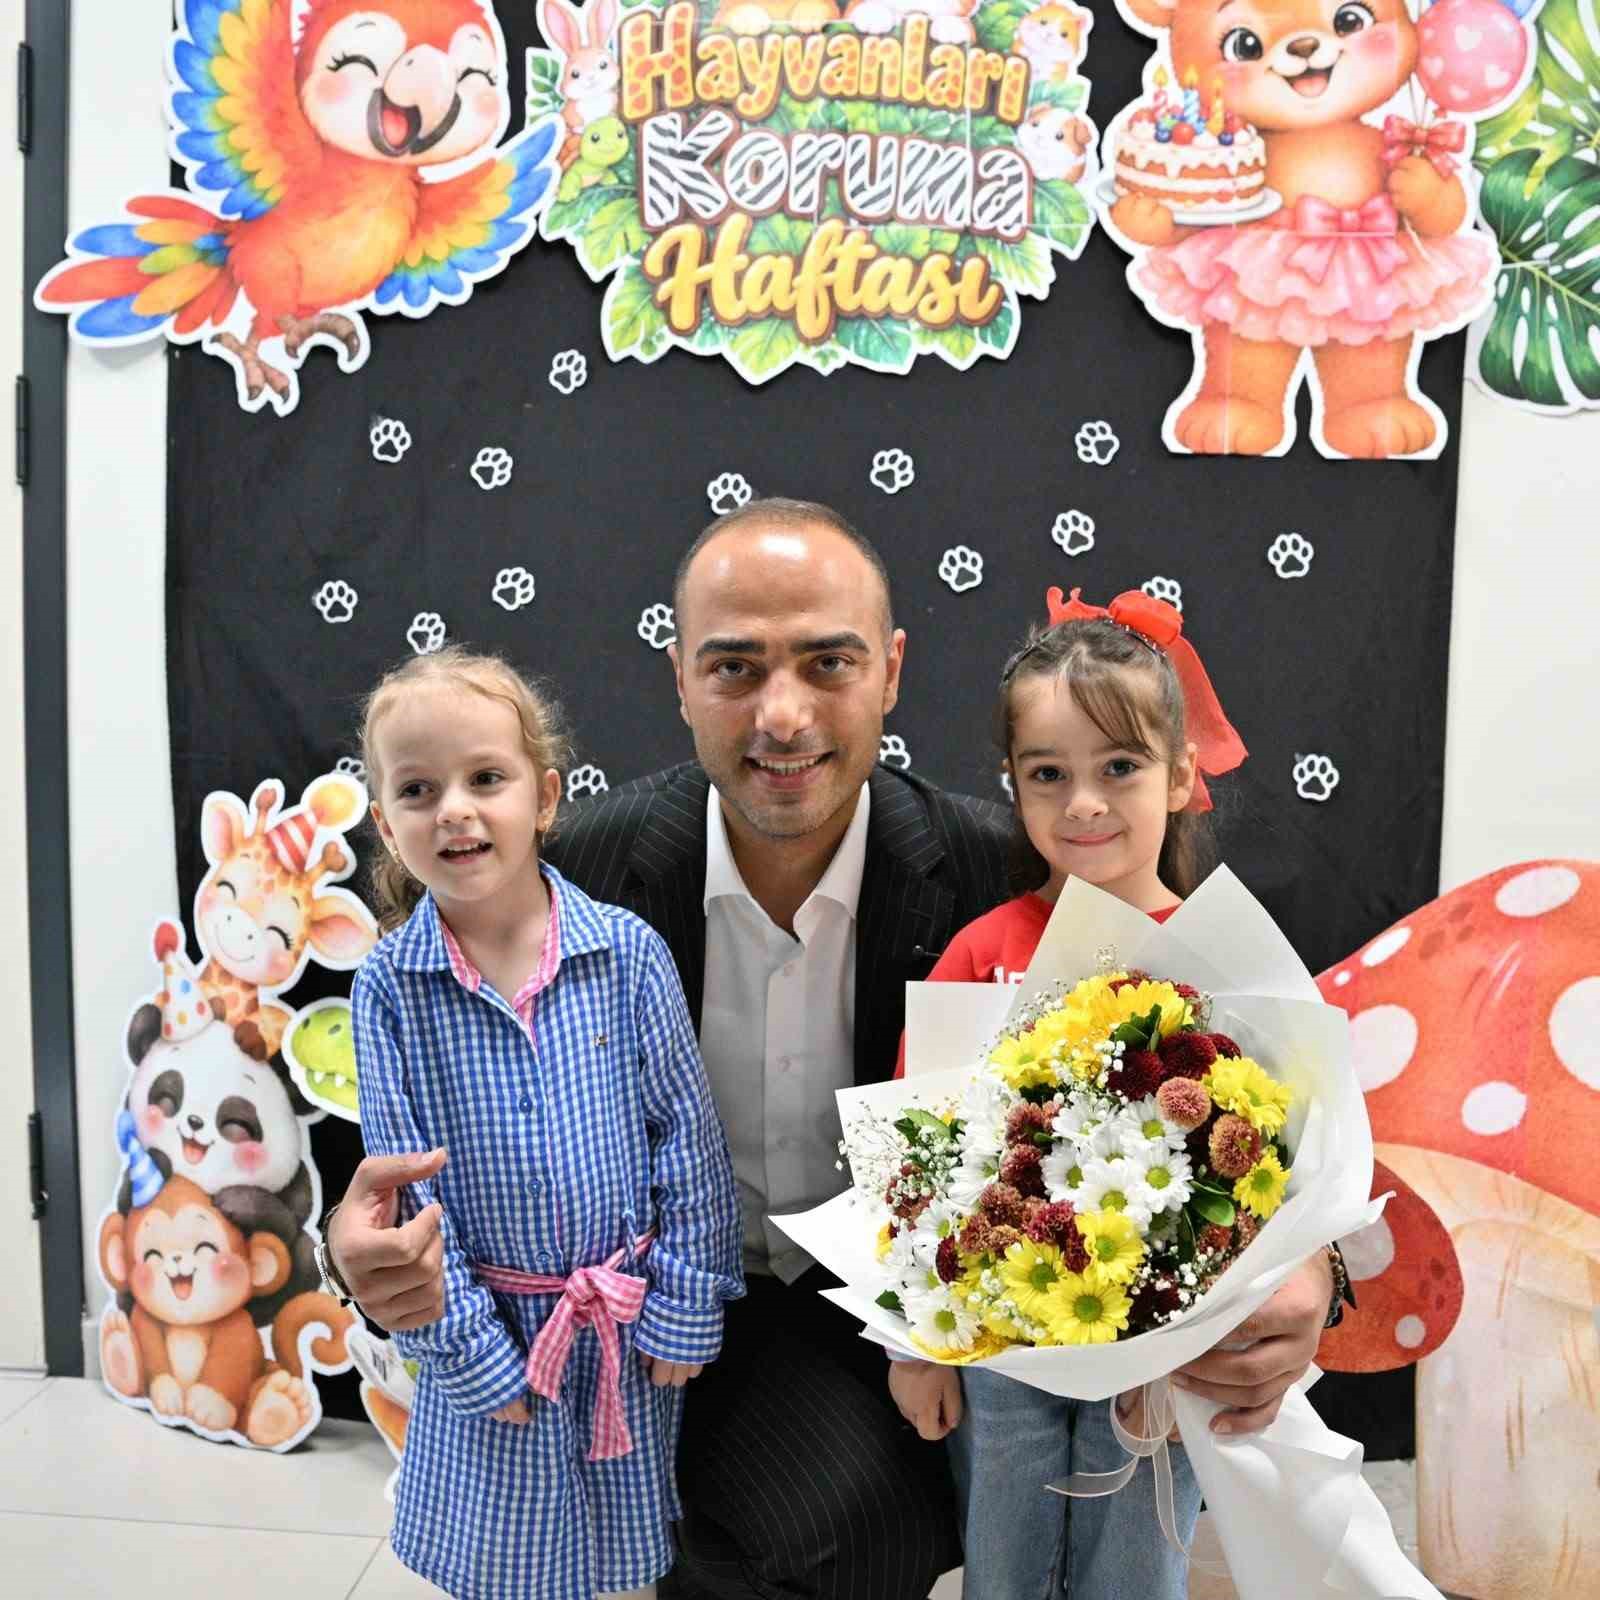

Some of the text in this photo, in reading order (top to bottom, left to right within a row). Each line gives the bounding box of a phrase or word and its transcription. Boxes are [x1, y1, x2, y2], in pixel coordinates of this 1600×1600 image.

[621, 2, 1029, 122] Hayvanları
[641, 110, 1030, 236] Koruma
[645, 215, 1002, 340] Haftası
